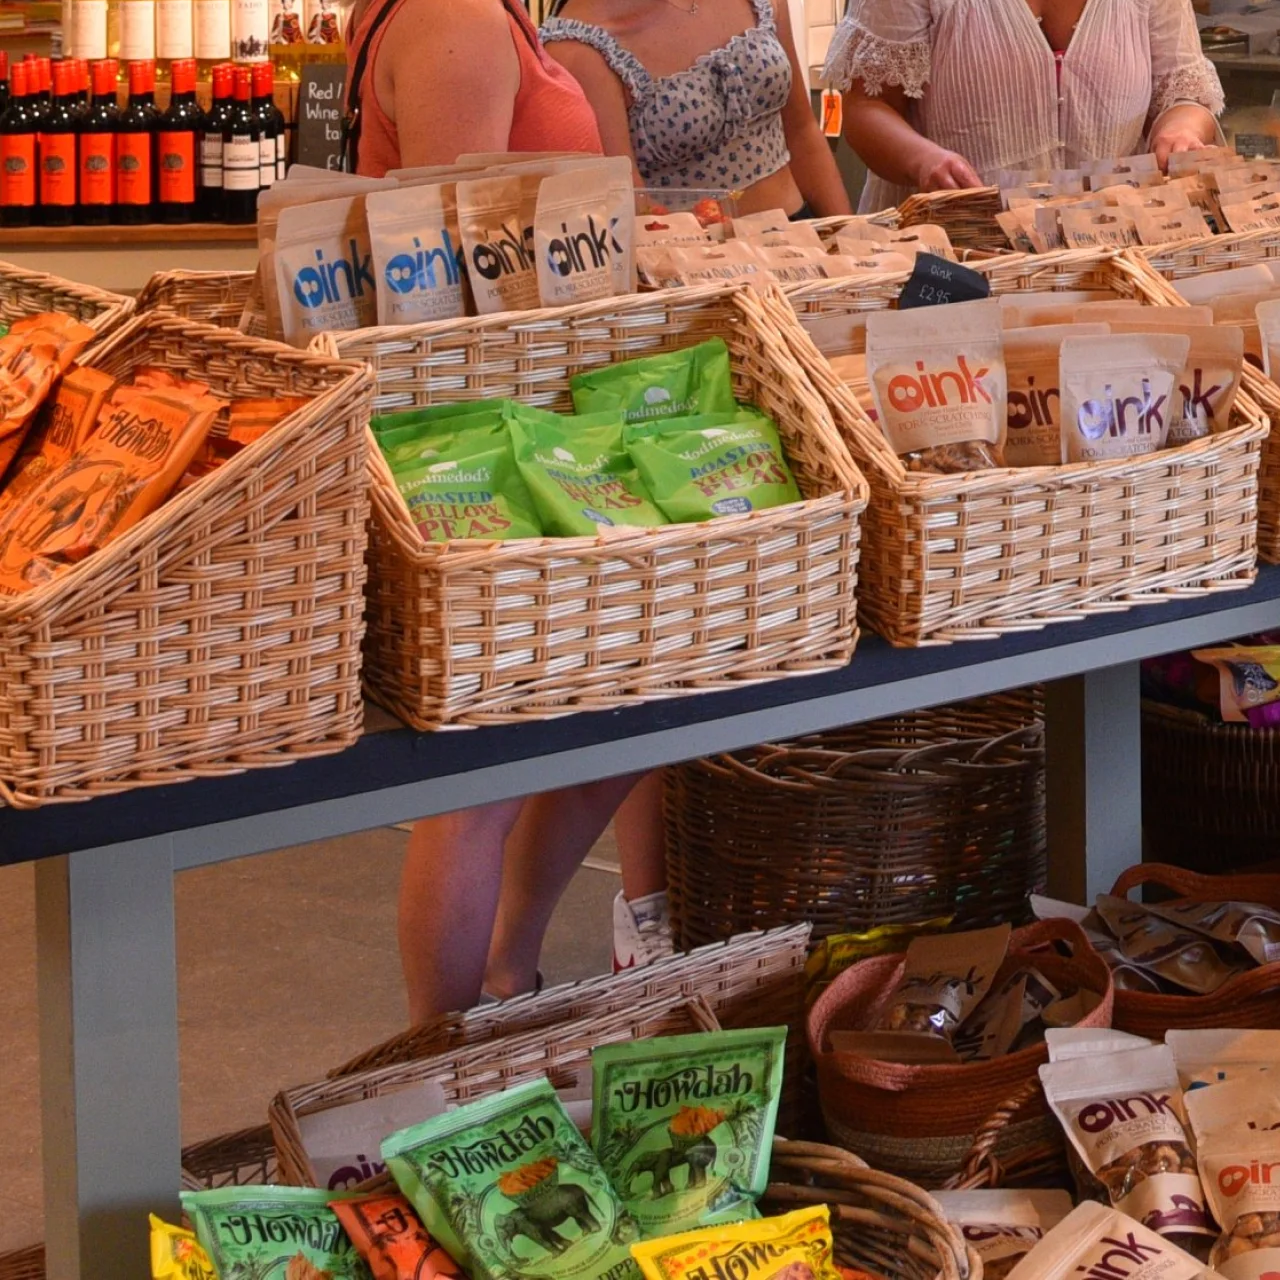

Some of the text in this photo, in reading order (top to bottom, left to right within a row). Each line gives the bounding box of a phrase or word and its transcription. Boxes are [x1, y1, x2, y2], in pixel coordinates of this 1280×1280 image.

[305, 104, 340, 120] Wine
[308, 82, 333, 100] Red
[385, 228, 469, 295] oink
[473, 223, 532, 280] oink
[548, 215, 611, 277] oink
[930, 264, 953, 281] Oink
[294, 238, 376, 309] oink
[887, 355, 993, 413] oink
[1007, 376, 1060, 429] oin
[1078, 378, 1167, 440] oink
[99, 410, 173, 464] Howdah
[690, 442, 772, 478] ROASTED
[693, 450, 778, 490] YELLOW
[701, 463, 789, 497] PEAS
[409, 502, 504, 521] YELLOW
[414, 516, 512, 542] PEAS
[614, 1061, 753, 1114] Howdah
[1078, 1091, 1172, 1133] oink
[426, 1114, 557, 1180] Howdah
